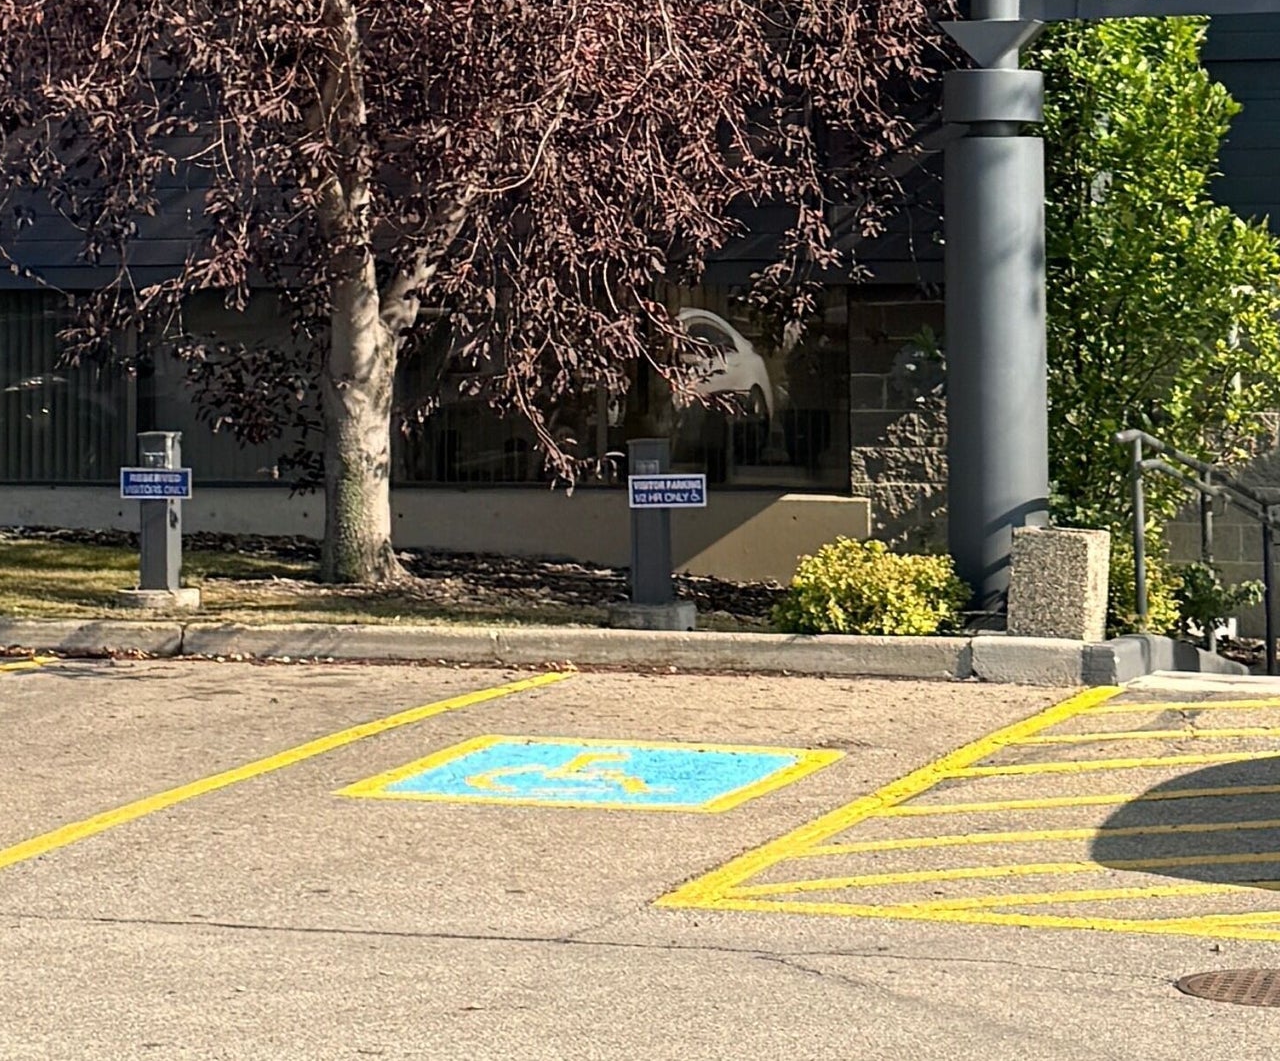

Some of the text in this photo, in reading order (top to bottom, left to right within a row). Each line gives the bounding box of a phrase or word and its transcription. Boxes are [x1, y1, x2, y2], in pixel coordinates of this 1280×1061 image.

[163, 484, 187, 494] ONLY
[633, 480, 665, 490] VISITOR
[664, 491, 689, 502] ONLY
